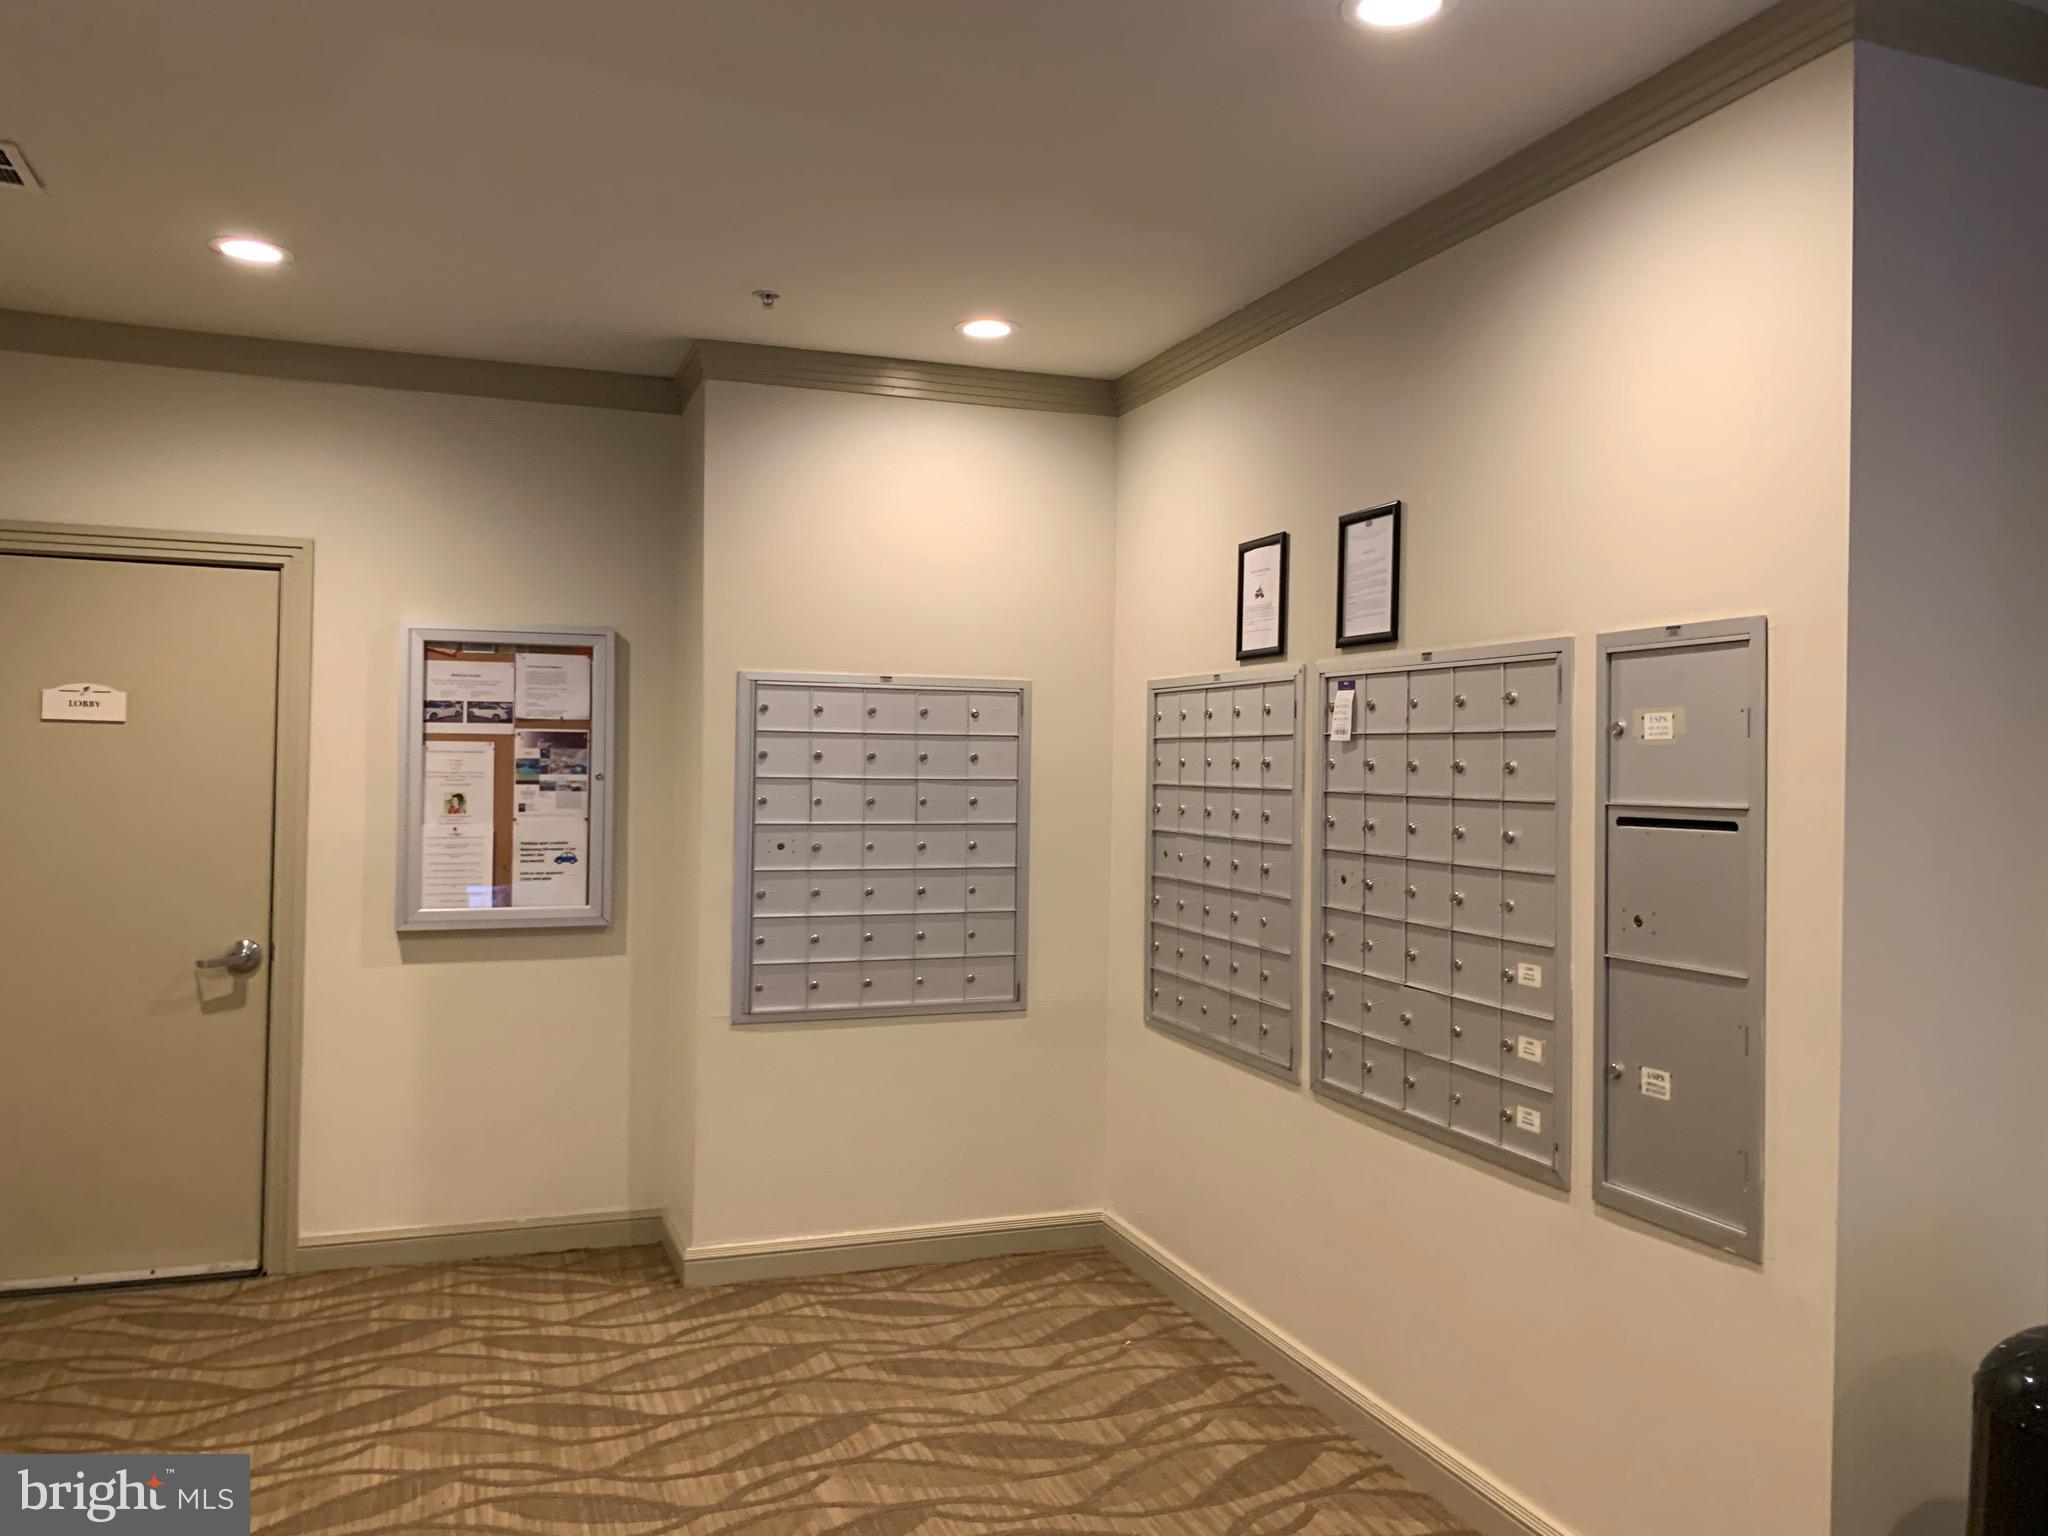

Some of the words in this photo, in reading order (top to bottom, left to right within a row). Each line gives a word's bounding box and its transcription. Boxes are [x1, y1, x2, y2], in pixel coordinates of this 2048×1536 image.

[68, 699, 101, 708] LOBBY
[1649, 715, 1668, 724] USPS
[1647, 1072, 1665, 1082] USPS
